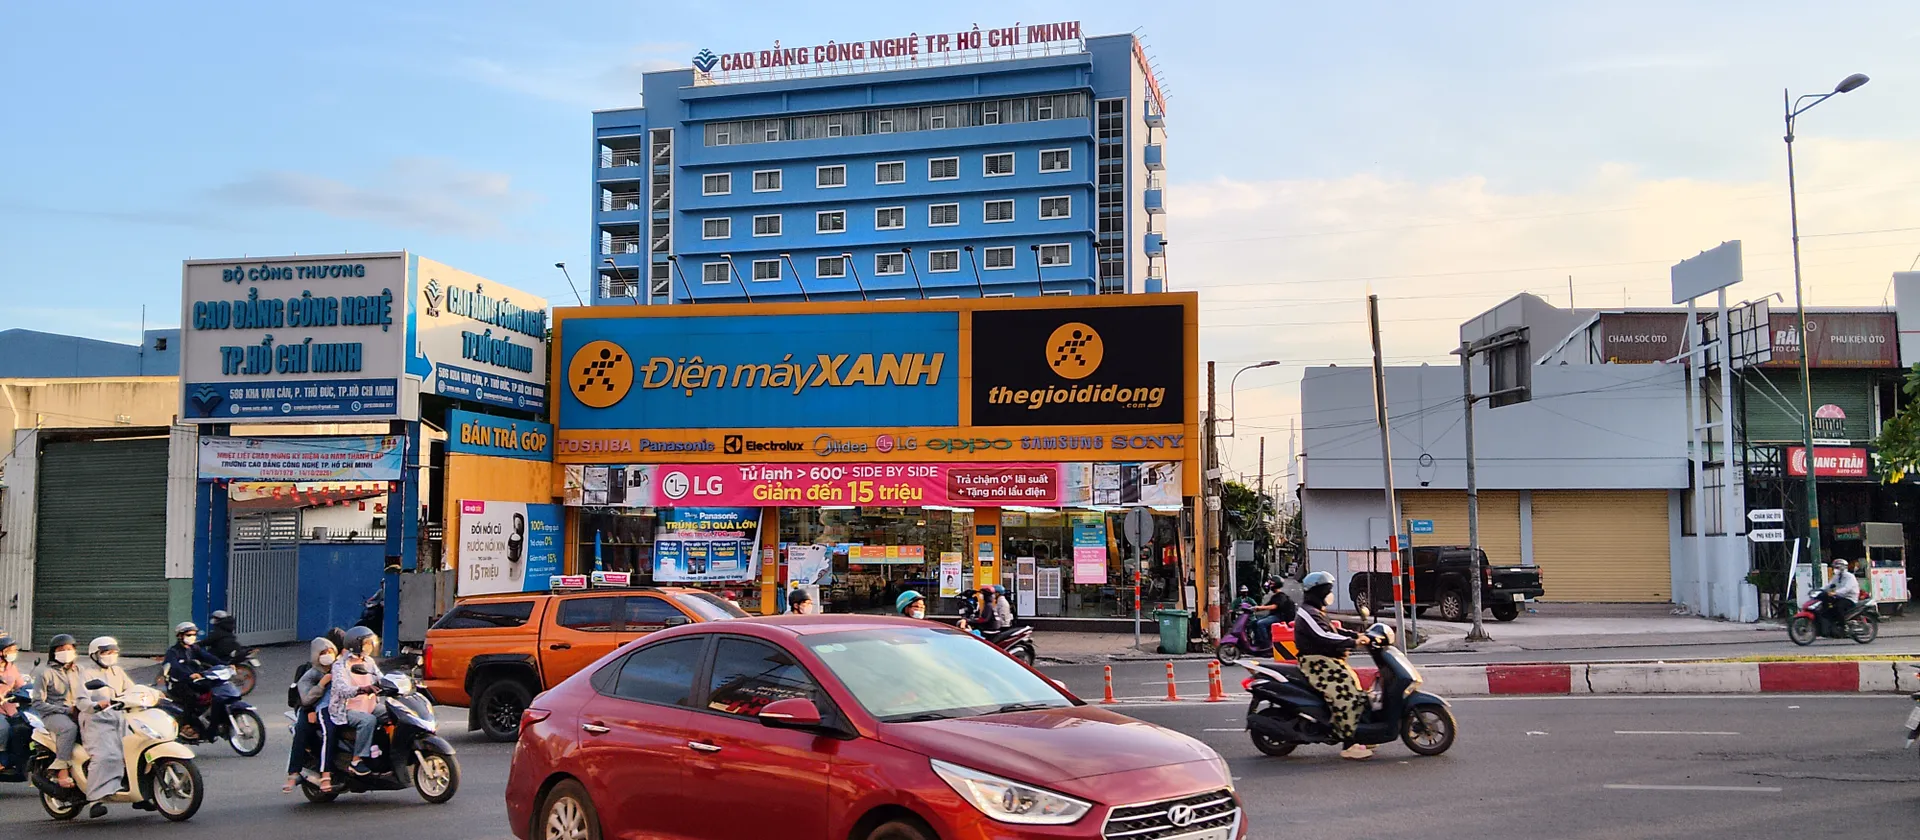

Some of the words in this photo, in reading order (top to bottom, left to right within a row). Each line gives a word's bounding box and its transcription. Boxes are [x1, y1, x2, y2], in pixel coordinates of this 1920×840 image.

[720, 53, 754, 72] CAO
[760, 39, 809, 68] ĐẲNG
[814, 40, 864, 63] CÔNG
[870, 32, 918, 60] NGHỆ
[926, 34, 950, 52] TP.
[957, 22, 981, 50] HỒ
[988, 22, 1020, 48] CHÍ
[1027, 21, 1080, 44] MINH
[222, 266, 244, 284] BỘ
[248, 265, 292, 281] CÔNG
[295, 264, 365, 280] THƯƠNG
[193, 300, 230, 330] CAO
[232, 287, 284, 330] ĐẲNG
[287, 290, 338, 328] CÔNG
[341, 288, 392, 332] NGHỆ
[447, 285, 472, 317] CAO
[470, 283, 498, 327] ĐẲNG
[498, 297, 521, 332] CÔNG
[521, 308, 548, 342] NGHỆ
[220, 334, 273, 375] TP.HỒ
[276, 337, 312, 374] CHÍ
[312, 343, 362, 373] MINH
[491, 336, 510, 368] CHÍ
[508, 342, 533, 374] MINH
[640, 356, 726, 396] Điện
[230, 388, 244, 400] 586
[246, 388, 260, 399] KHA
[261, 388, 276, 400] VẠN
[294, 387, 302, 398] P.
[304, 384, 318, 398] THỦ
[375, 385, 394, 396] MINH
[988, 384, 1166, 410] thegioididong
[461, 419, 490, 446] BÁN
[493, 422, 518, 450] TRẢ
[521, 428, 547, 452] GÓP
[640, 438, 715, 452] Panasonic
[897, 438, 918, 450] LG
[1021, 436, 1104, 450] SAMSUNG
[1112, 434, 1184, 449] SONY
[558, 439, 632, 452] TOSHIBA
[746, 440, 804, 451] Electrolux
[815, 436, 868, 455] Midea
[740, 466, 758, 480] Tủ
[761, 468, 793, 482] lạnh
[796, 470, 806, 478] >
[852, 467, 882, 478] SIDE
[886, 466, 904, 478] BY
[909, 466, 938, 477] SIDE
[956, 474, 972, 484] Trả
[973, 474, 999, 486] chậm
[1016, 474, 1026, 484] lãi
[1028, 473, 1049, 484] suất
[694, 476, 723, 495] LG
[753, 482, 802, 500] Giảm
[806, 482, 842, 500] đến
[848, 481, 874, 503] 15
[879, 483, 923, 504] triệu
[966, 487, 990, 498] Tặng
[992, 486, 1006, 496] nồi
[1008, 484, 1024, 496] lẩu
[1025, 486, 1046, 498] điện
[666, 520, 698, 530] TRÚNG
[700, 521, 710, 529] 31
[713, 520, 734, 530] QUÀ
[736, 520, 757, 529] LỚN
